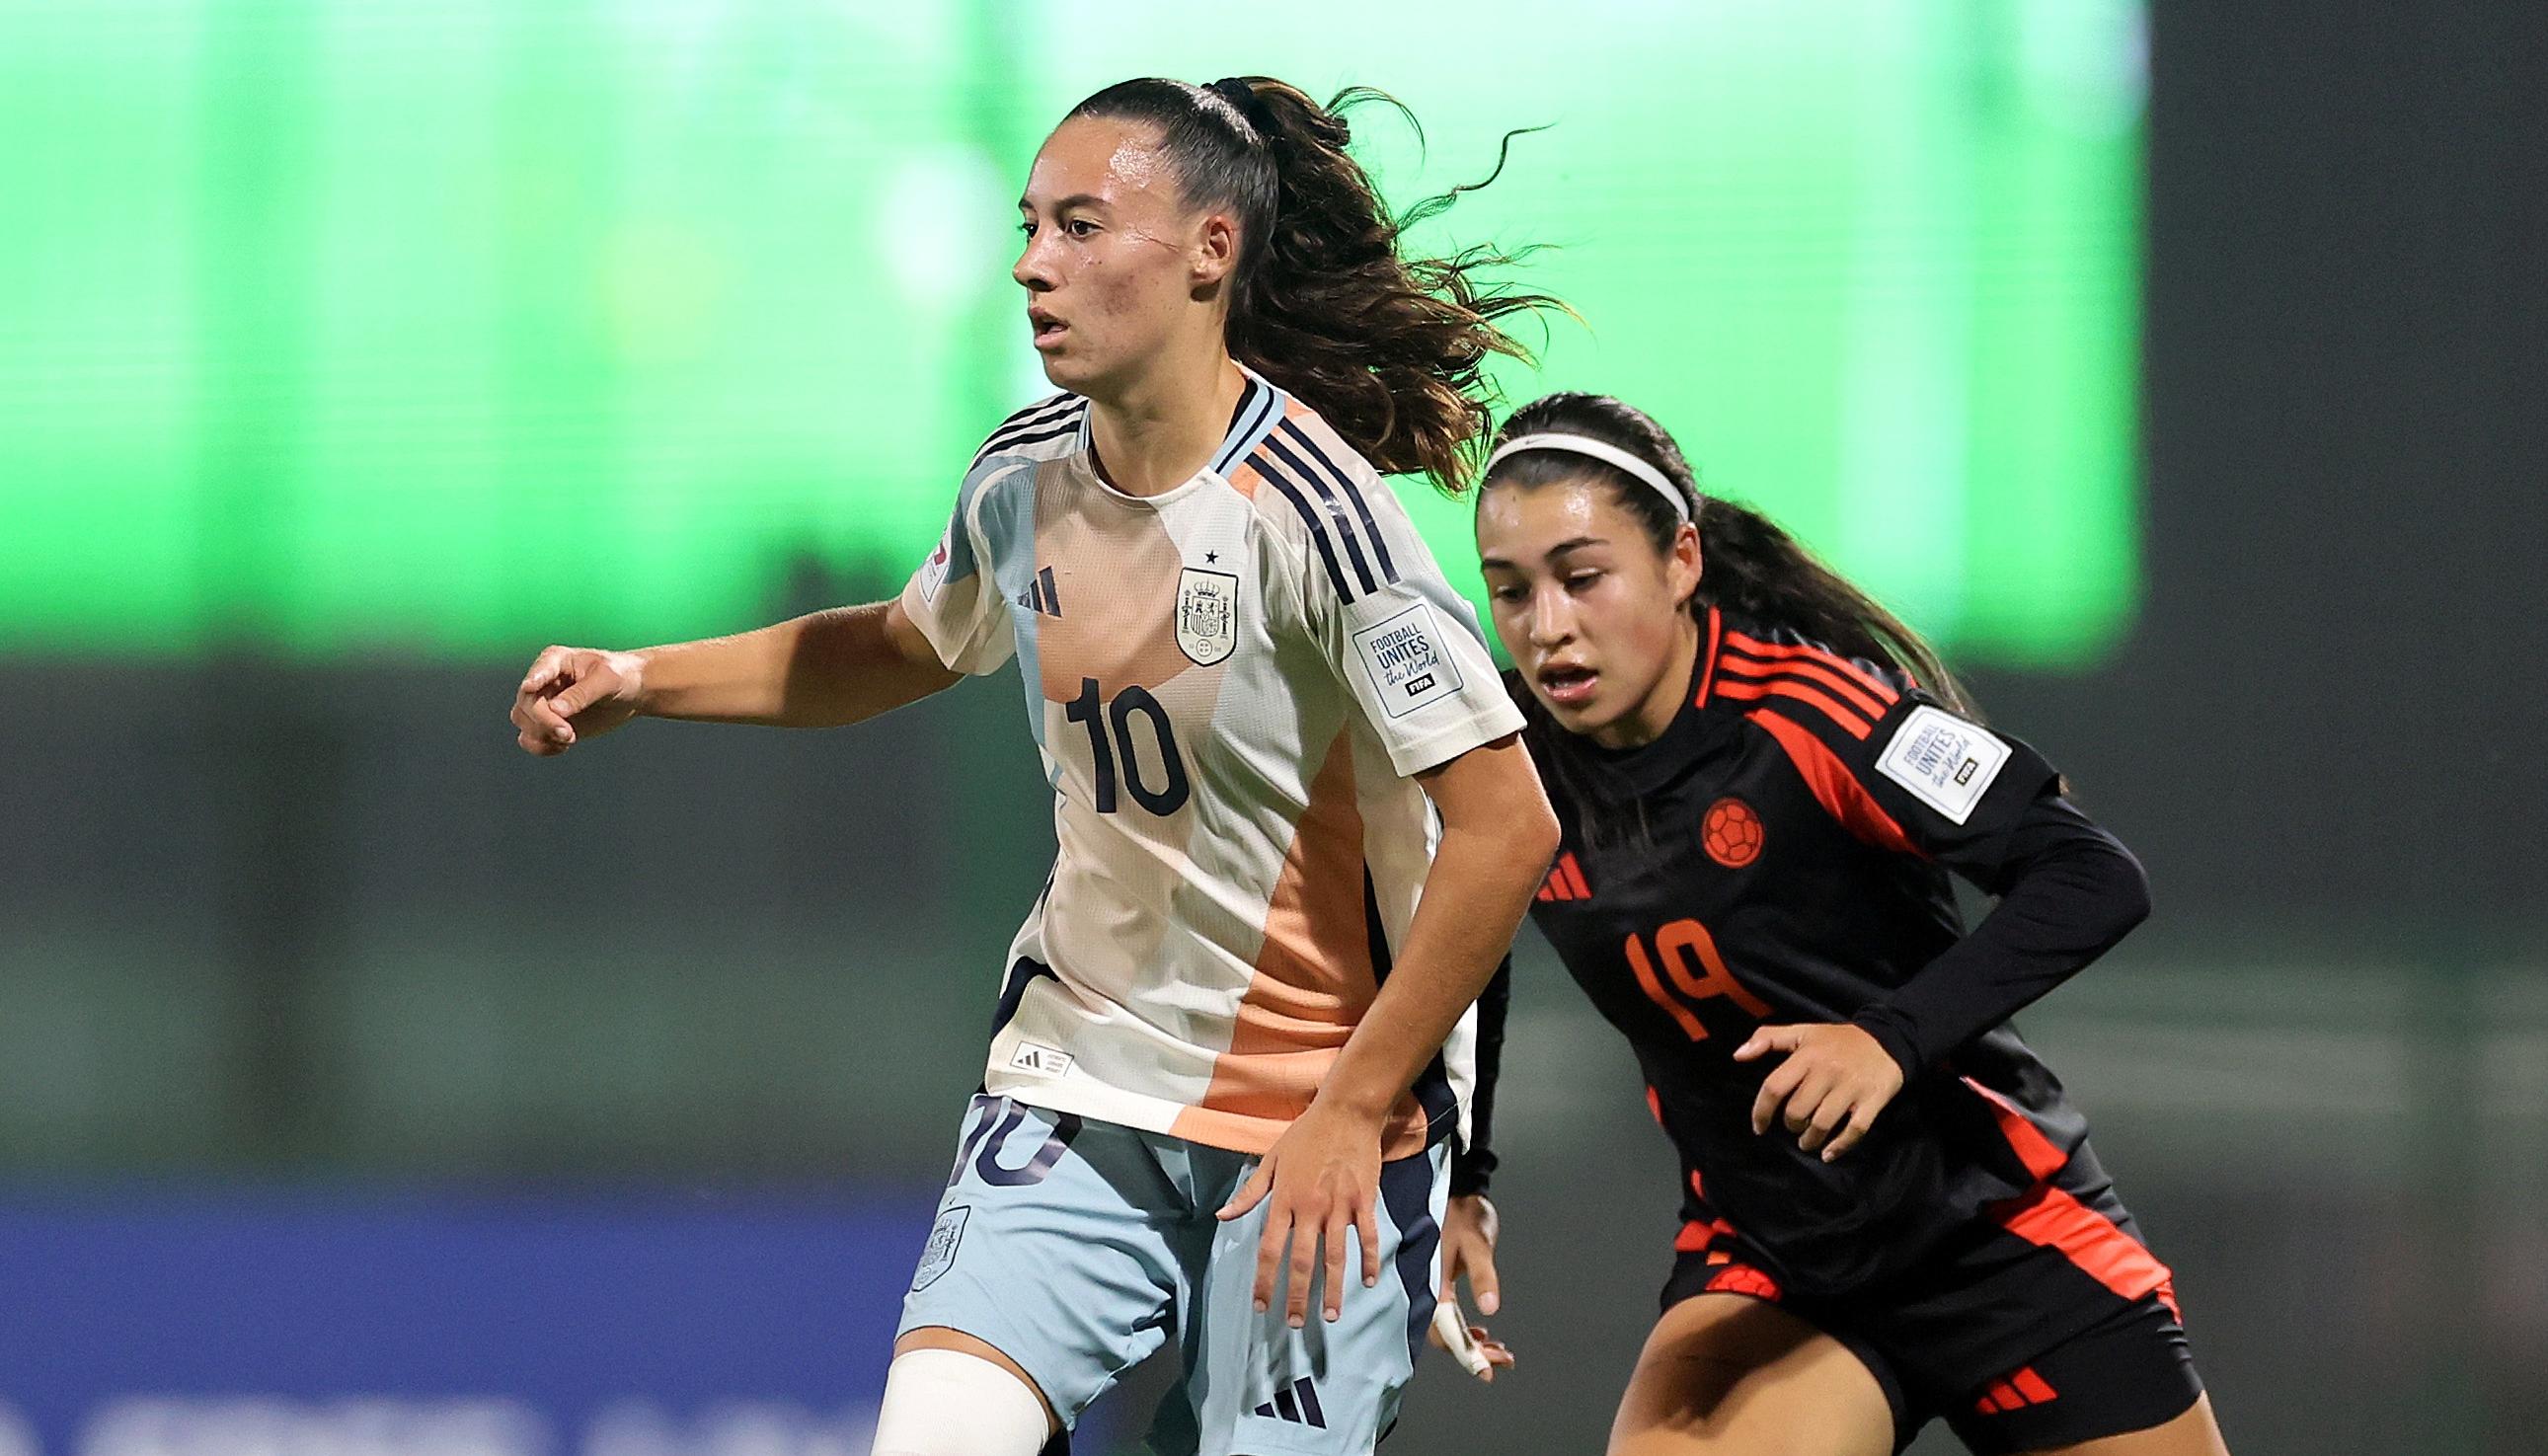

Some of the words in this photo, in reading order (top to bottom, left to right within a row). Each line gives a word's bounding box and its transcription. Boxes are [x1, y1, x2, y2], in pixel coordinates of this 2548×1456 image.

[1370, 623, 1422, 653] FOOTBALL
[1376, 635, 1429, 669] UNITES
[1384, 668, 1405, 686] the
[1403, 650, 1440, 676] World
[1408, 676, 1433, 695] FIFA
[1065, 677, 1190, 816] 10
[1903, 724, 1939, 765] FOOTBALL
[1916, 728, 1956, 776] UNITES
[1624, 917, 1776, 1042] 19
